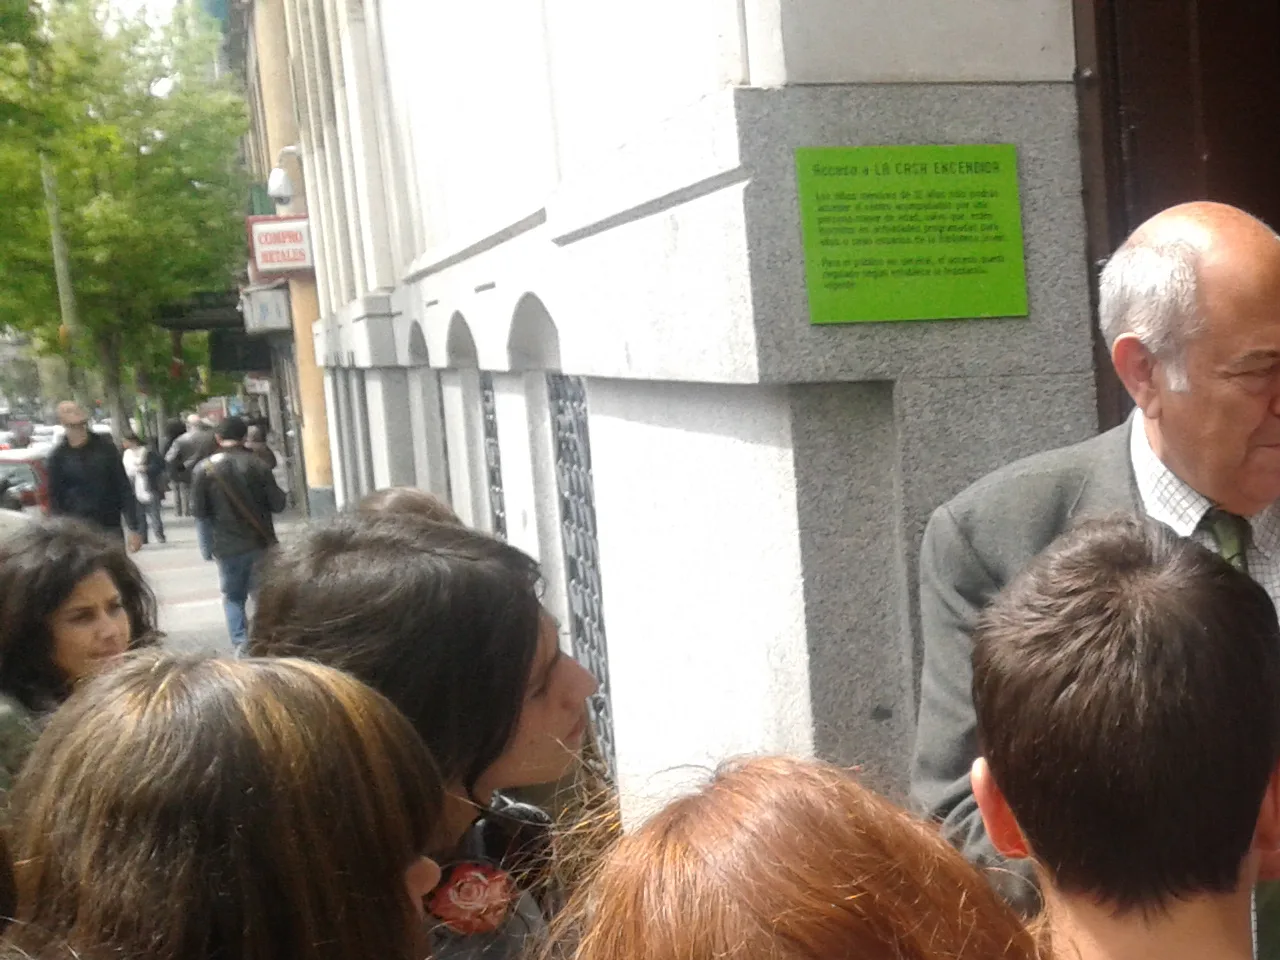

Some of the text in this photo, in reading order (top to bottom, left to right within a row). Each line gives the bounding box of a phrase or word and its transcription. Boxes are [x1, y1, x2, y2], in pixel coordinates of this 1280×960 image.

[874, 162, 890, 176] LA
[895, 162, 928, 175] CASA
[258, 231, 303, 244] COMPRO
